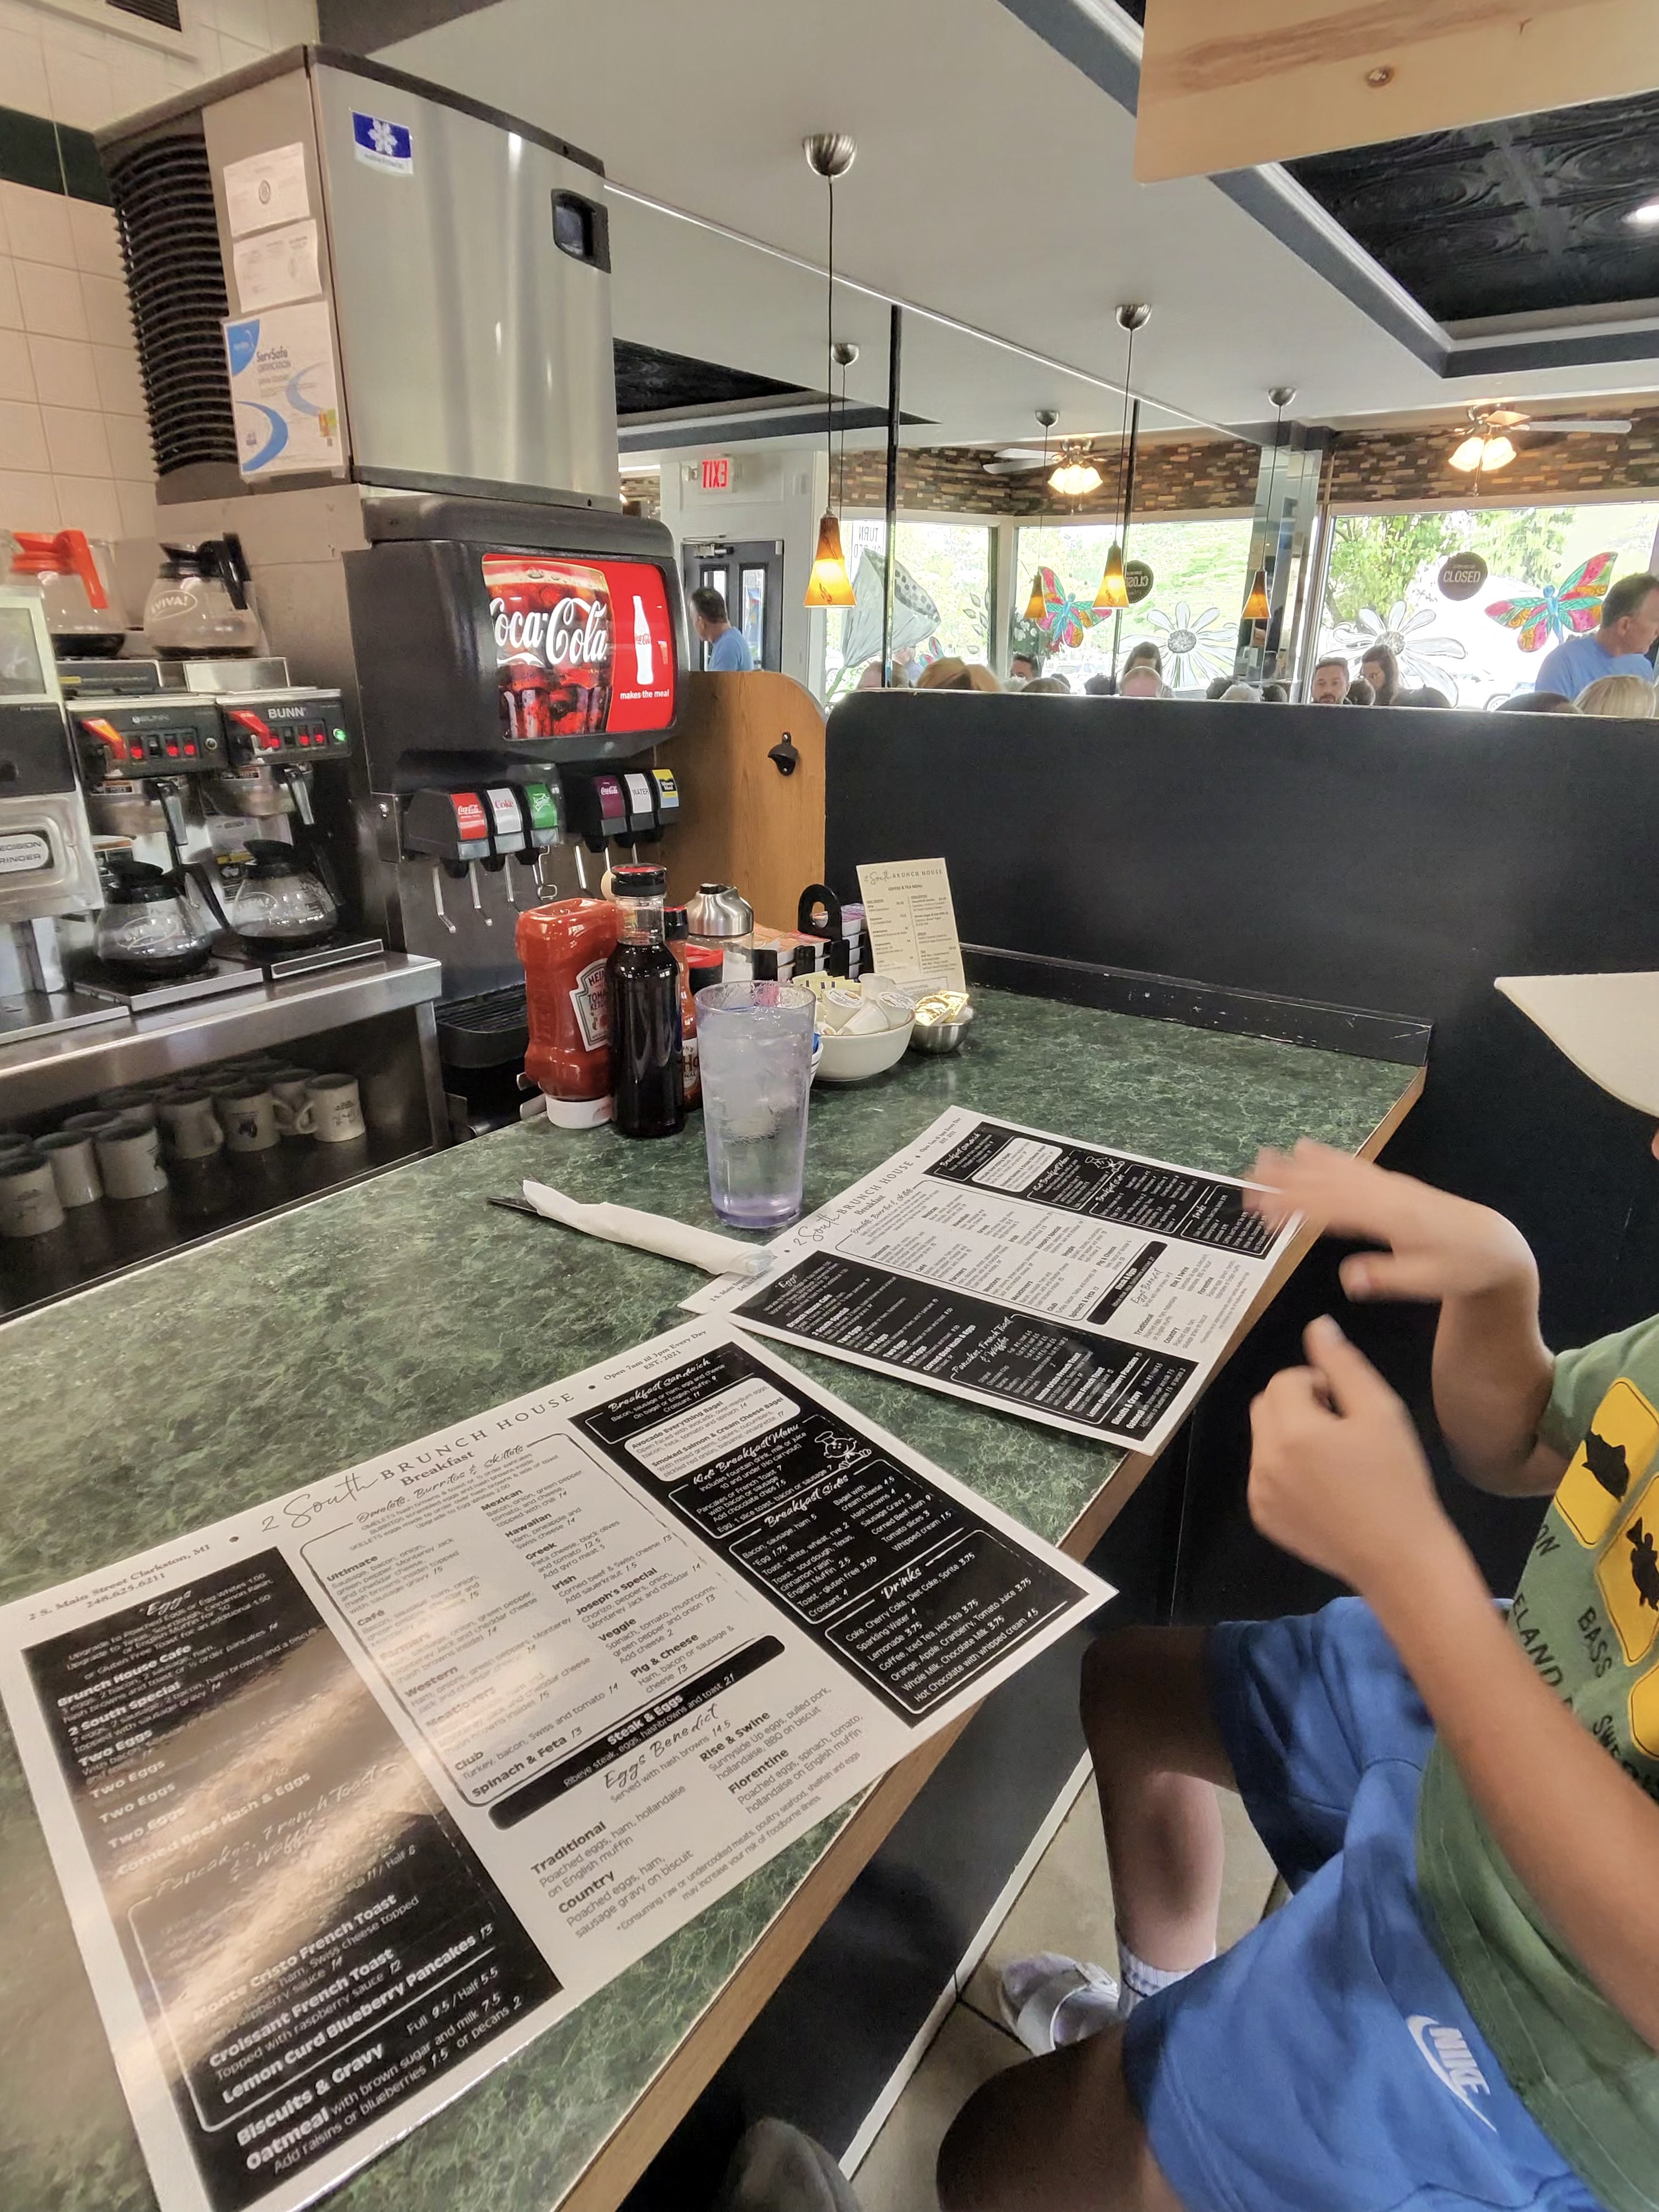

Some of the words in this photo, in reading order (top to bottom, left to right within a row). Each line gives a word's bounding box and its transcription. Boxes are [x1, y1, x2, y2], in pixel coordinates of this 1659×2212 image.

[1443, 571, 1481, 583] CLOSED
[620, 691, 641, 700] makes
[654, 689, 669, 697] meal
[268, 707, 304, 719] BUNN
[495, 800, 514, 810] Coke
[632, 788, 649, 796] WATER
[0, 842, 41, 851] ECISION
[0, 854, 41, 864] RINDER
[588, 970, 604, 986] HEI
[588, 990, 606, 1004] TOM
[879, 1160, 913, 1185] HOUSE
[837, 1184, 882, 1215] BRUNCH
[854, 1194, 886, 1215] Breakfast
[793, 1237, 807, 1246] 2
[798, 1212, 840, 1243] South
[786, 1313, 808, 1328] Brunch
[803, 1302, 822, 1315] House
[818, 1294, 833, 1304] Cafe
[603, 1369, 626, 1380] Open
[625, 1361, 644, 1370] 7am
[652, 1348, 670, 1357] 3pm
[668, 1338, 691, 1349] Every
[690, 1330, 707, 1339] Day
[642, 1359, 663, 1370] EST.
[662, 1350, 681, 1361] 2021
[922, 1355, 943, 1371] Corned
[938, 1346, 952, 1357] Beef
[947, 1337, 963, 1348] Hash
[961, 1324, 976, 1335] Eggs
[261, 1515, 279, 1532] 2
[283, 1472, 379, 1528] South
[380, 1429, 488, 1481] BRUNCH
[495, 1393, 574, 1430] HOUSE
[399, 1451, 475, 1486] Breakfast
[480, 1489, 523, 1511] Mexican
[504, 1513, 552, 1538] Hawaiian
[326, 1556, 378, 1582] Ultimate
[525, 1542, 557, 1560] Greek
[55, 1594, 89, 1610] Main
[92, 1578, 127, 1596] Street
[129, 1555, 191, 1580] Clarkston,
[193, 1544, 210, 1555] MI
[86, 1572, 165, 1608] 248.625.6211
[551, 1575, 577, 1590] Irish
[575, 1588, 620, 1616] Joseph's
[620, 1567, 658, 1590] Special
[880, 1568, 922, 1599] Drinks
[845, 1628, 867, 1641] Coke,
[865, 1610, 890, 1629] Cherry
[888, 1600, 910, 1613] Coke,
[906, 1589, 923, 1601] Diet
[921, 1578, 941, 1591] Coke,
[938, 1564, 960, 1579] Sprite
[958, 1551, 975, 1566] 3.75
[597, 1618, 636, 1641] Veggie
[856, 1628, 890, 1651] Sparkling
[887, 1613, 910, 1630] Water
[911, 1607, 917, 1615] 4
[867, 1634, 905, 1661] Lemonade
[904, 1621, 922, 1637] 3.75
[890, 1661, 921, 1681] Orange,
[918, 1645, 943, 1662] Apple,
[939, 1620, 977, 1646] Cranberry,
[972, 1602, 1000, 1621] Tomato
[998, 1590, 1016, 1604] Juice
[1014, 1577, 1031, 1592] 3.75
[1577, 1606, 1613, 1679] BASS
[901, 1673, 927, 1691] Whole
[924, 1663, 943, 1675] Milk,
[940, 1638, 975, 1664] Chocolate
[972, 1628, 989, 1640] Milk
[987, 1615, 1005, 1630] 3.75
[913, 1689, 931, 1702] Hot
[928, 1664, 964, 1691] Chocolate
[962, 1653, 980, 1667] with
[977, 1632, 1007, 1656] whipped
[1005, 1617, 1028, 1635] cream
[1027, 1607, 1039, 1618] 4.5
[57, 1679, 112, 1707] Brunch
[113, 1660, 157, 1684] House
[159, 1645, 191, 1663] Cafe
[67, 1726, 78, 1736] 2
[81, 1706, 127, 1730] South
[128, 1681, 180, 1709] Special
[607, 1719, 645, 1745] Steak
[643, 1713, 655, 1723] &
[653, 1695, 683, 1716] Eggs
[603, 1754, 654, 1789] Eggs
[649, 1702, 718, 1758] Benedict
[699, 1742, 725, 1762] Rise
[725, 1735, 736, 1745] &
[735, 1712, 770, 1737] Swine
[455, 1751, 484, 1770] Club
[471, 1762, 525, 1797] Spinach
[526, 1755, 537, 1764] &
[537, 1736, 567, 1758] Feta
[571, 1726, 582, 1739] 13
[727, 1750, 789, 1794] Florentine
[530, 1820, 606, 1874] Traditional
[558, 1871, 614, 1913] Country
[222, 2059, 284, 2103] Lemon
[284, 2031, 326, 2064] Curd
[326, 1982, 404, 2038] Blueberry
[405, 1935, 476, 1987] Pancakes
[480, 1923, 493, 1938] 13
[1429, 2027, 1492, 2096] NIKE
[236, 2090, 313, 2146] Biscuits
[315, 2079, 330, 2095] &
[331, 2043, 382, 2083] Gravy
[246, 2106, 330, 2170] Oatmeal
[331, 2092, 358, 2114] with
[359, 2066, 398, 2095] brown
[400, 2042, 430, 2068] sugar
[435, 2024, 455, 2045] and
[456, 2010, 478, 2030] milk
[481, 1993, 500, 2012] 7.5
